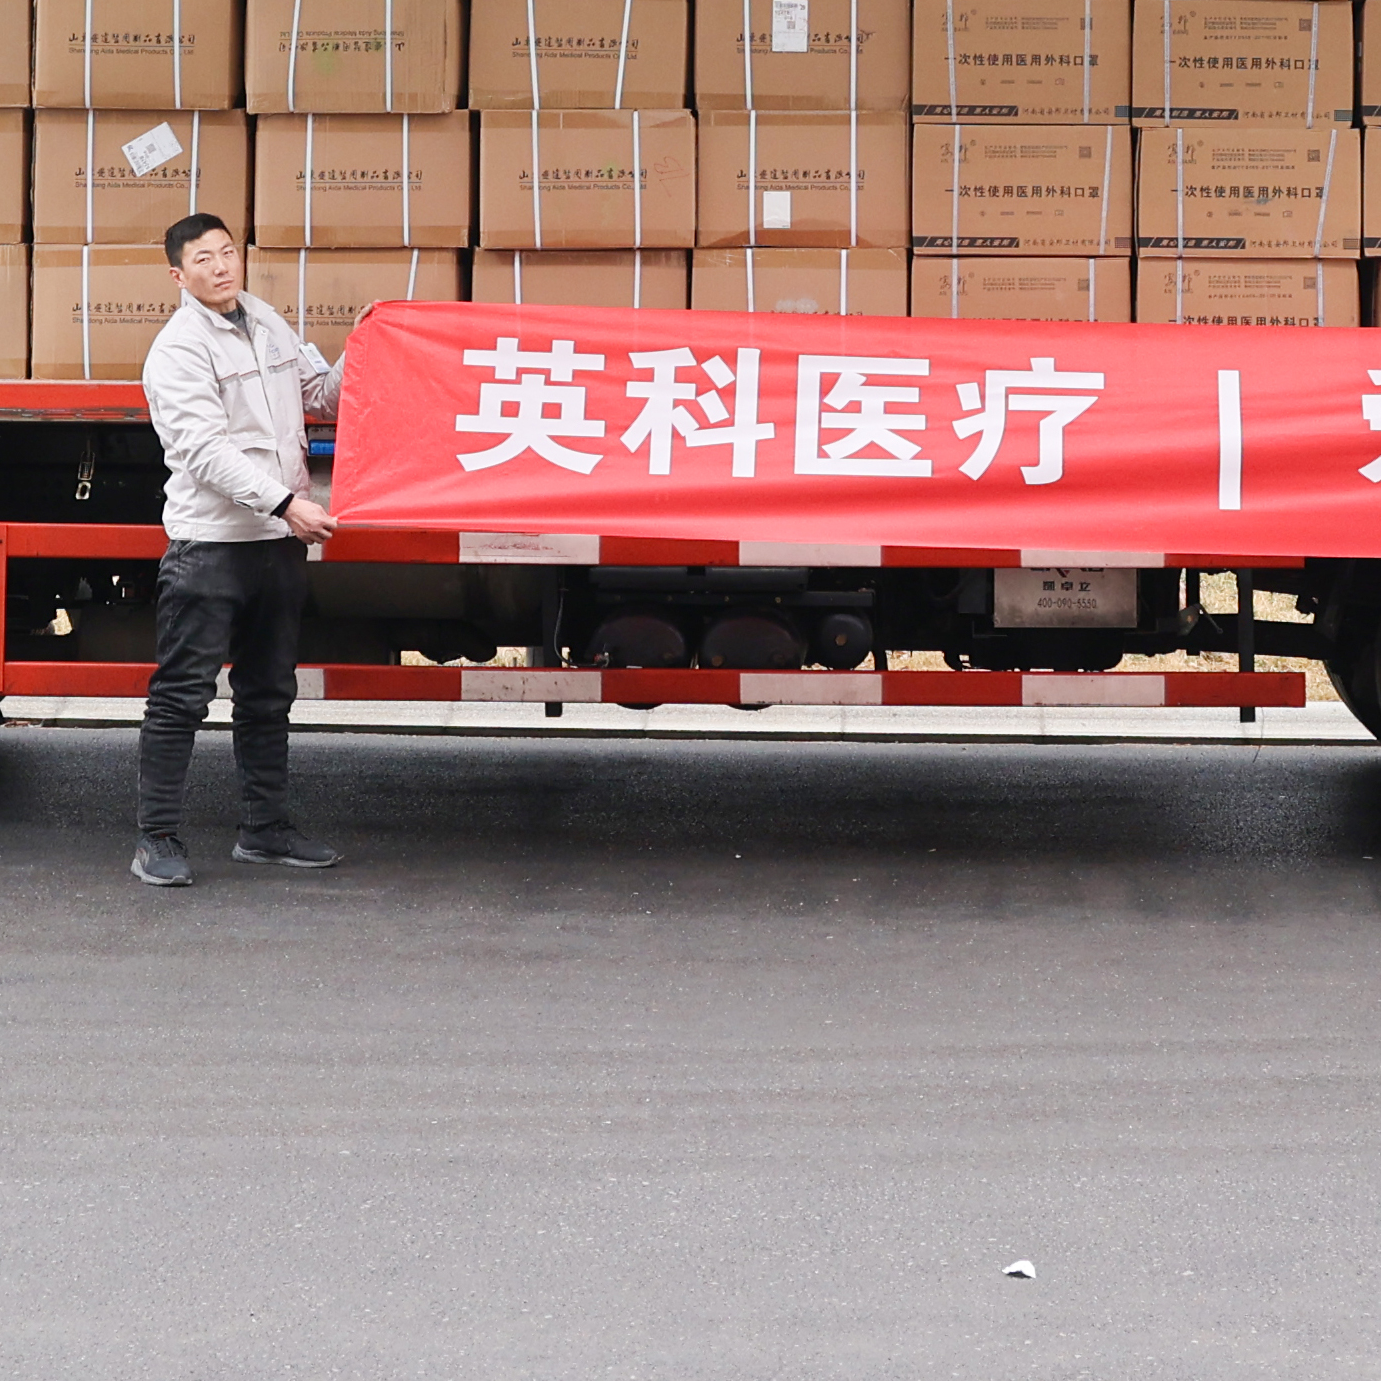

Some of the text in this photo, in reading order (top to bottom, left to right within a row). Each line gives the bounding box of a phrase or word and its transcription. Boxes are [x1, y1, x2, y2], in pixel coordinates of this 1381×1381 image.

[944, 185, 1099, 198] 一次性使用医用外科口罩
[456, 338, 1104, 484] 英科医疗
